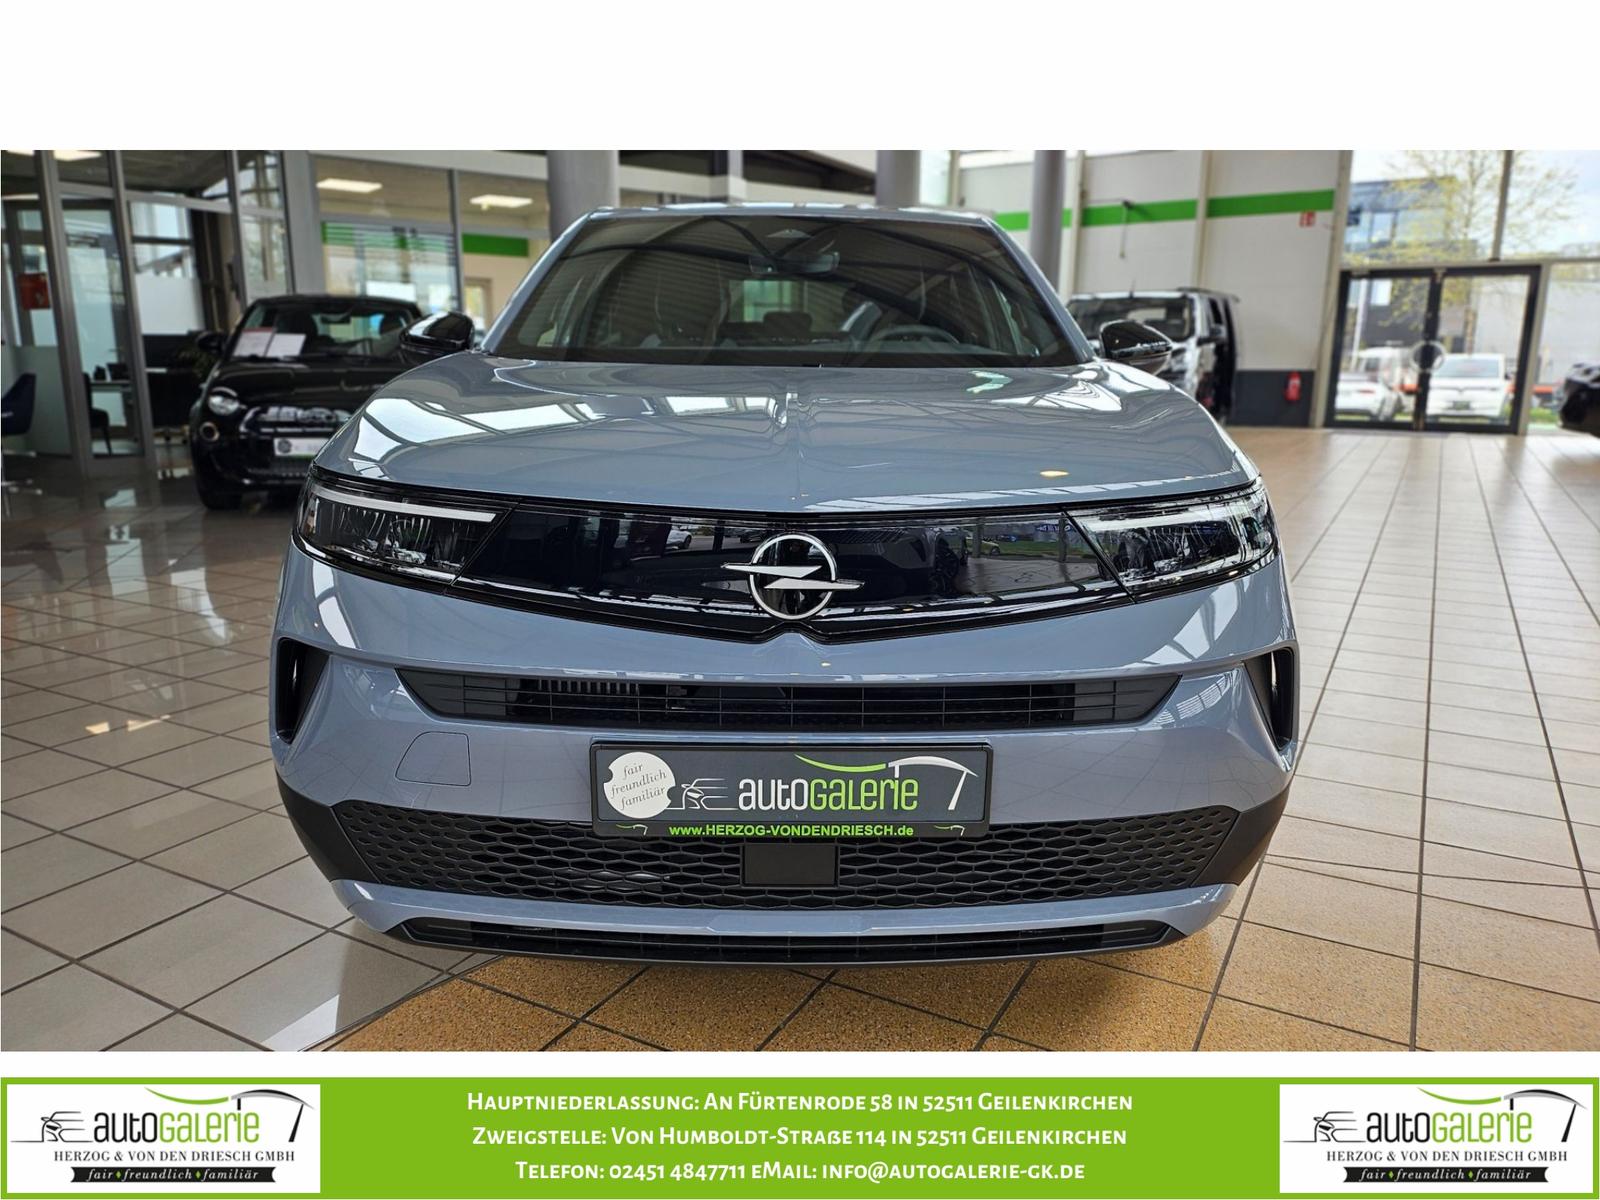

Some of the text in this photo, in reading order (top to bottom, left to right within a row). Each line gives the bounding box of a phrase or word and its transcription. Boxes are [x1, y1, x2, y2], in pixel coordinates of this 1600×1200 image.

[622, 763, 643, 780] fair
[610, 769, 667, 799] freundlich
[620, 787, 665, 811] familiär
[669, 824, 914, 837] www.HERZOG-VONDENDRIESCH.de
